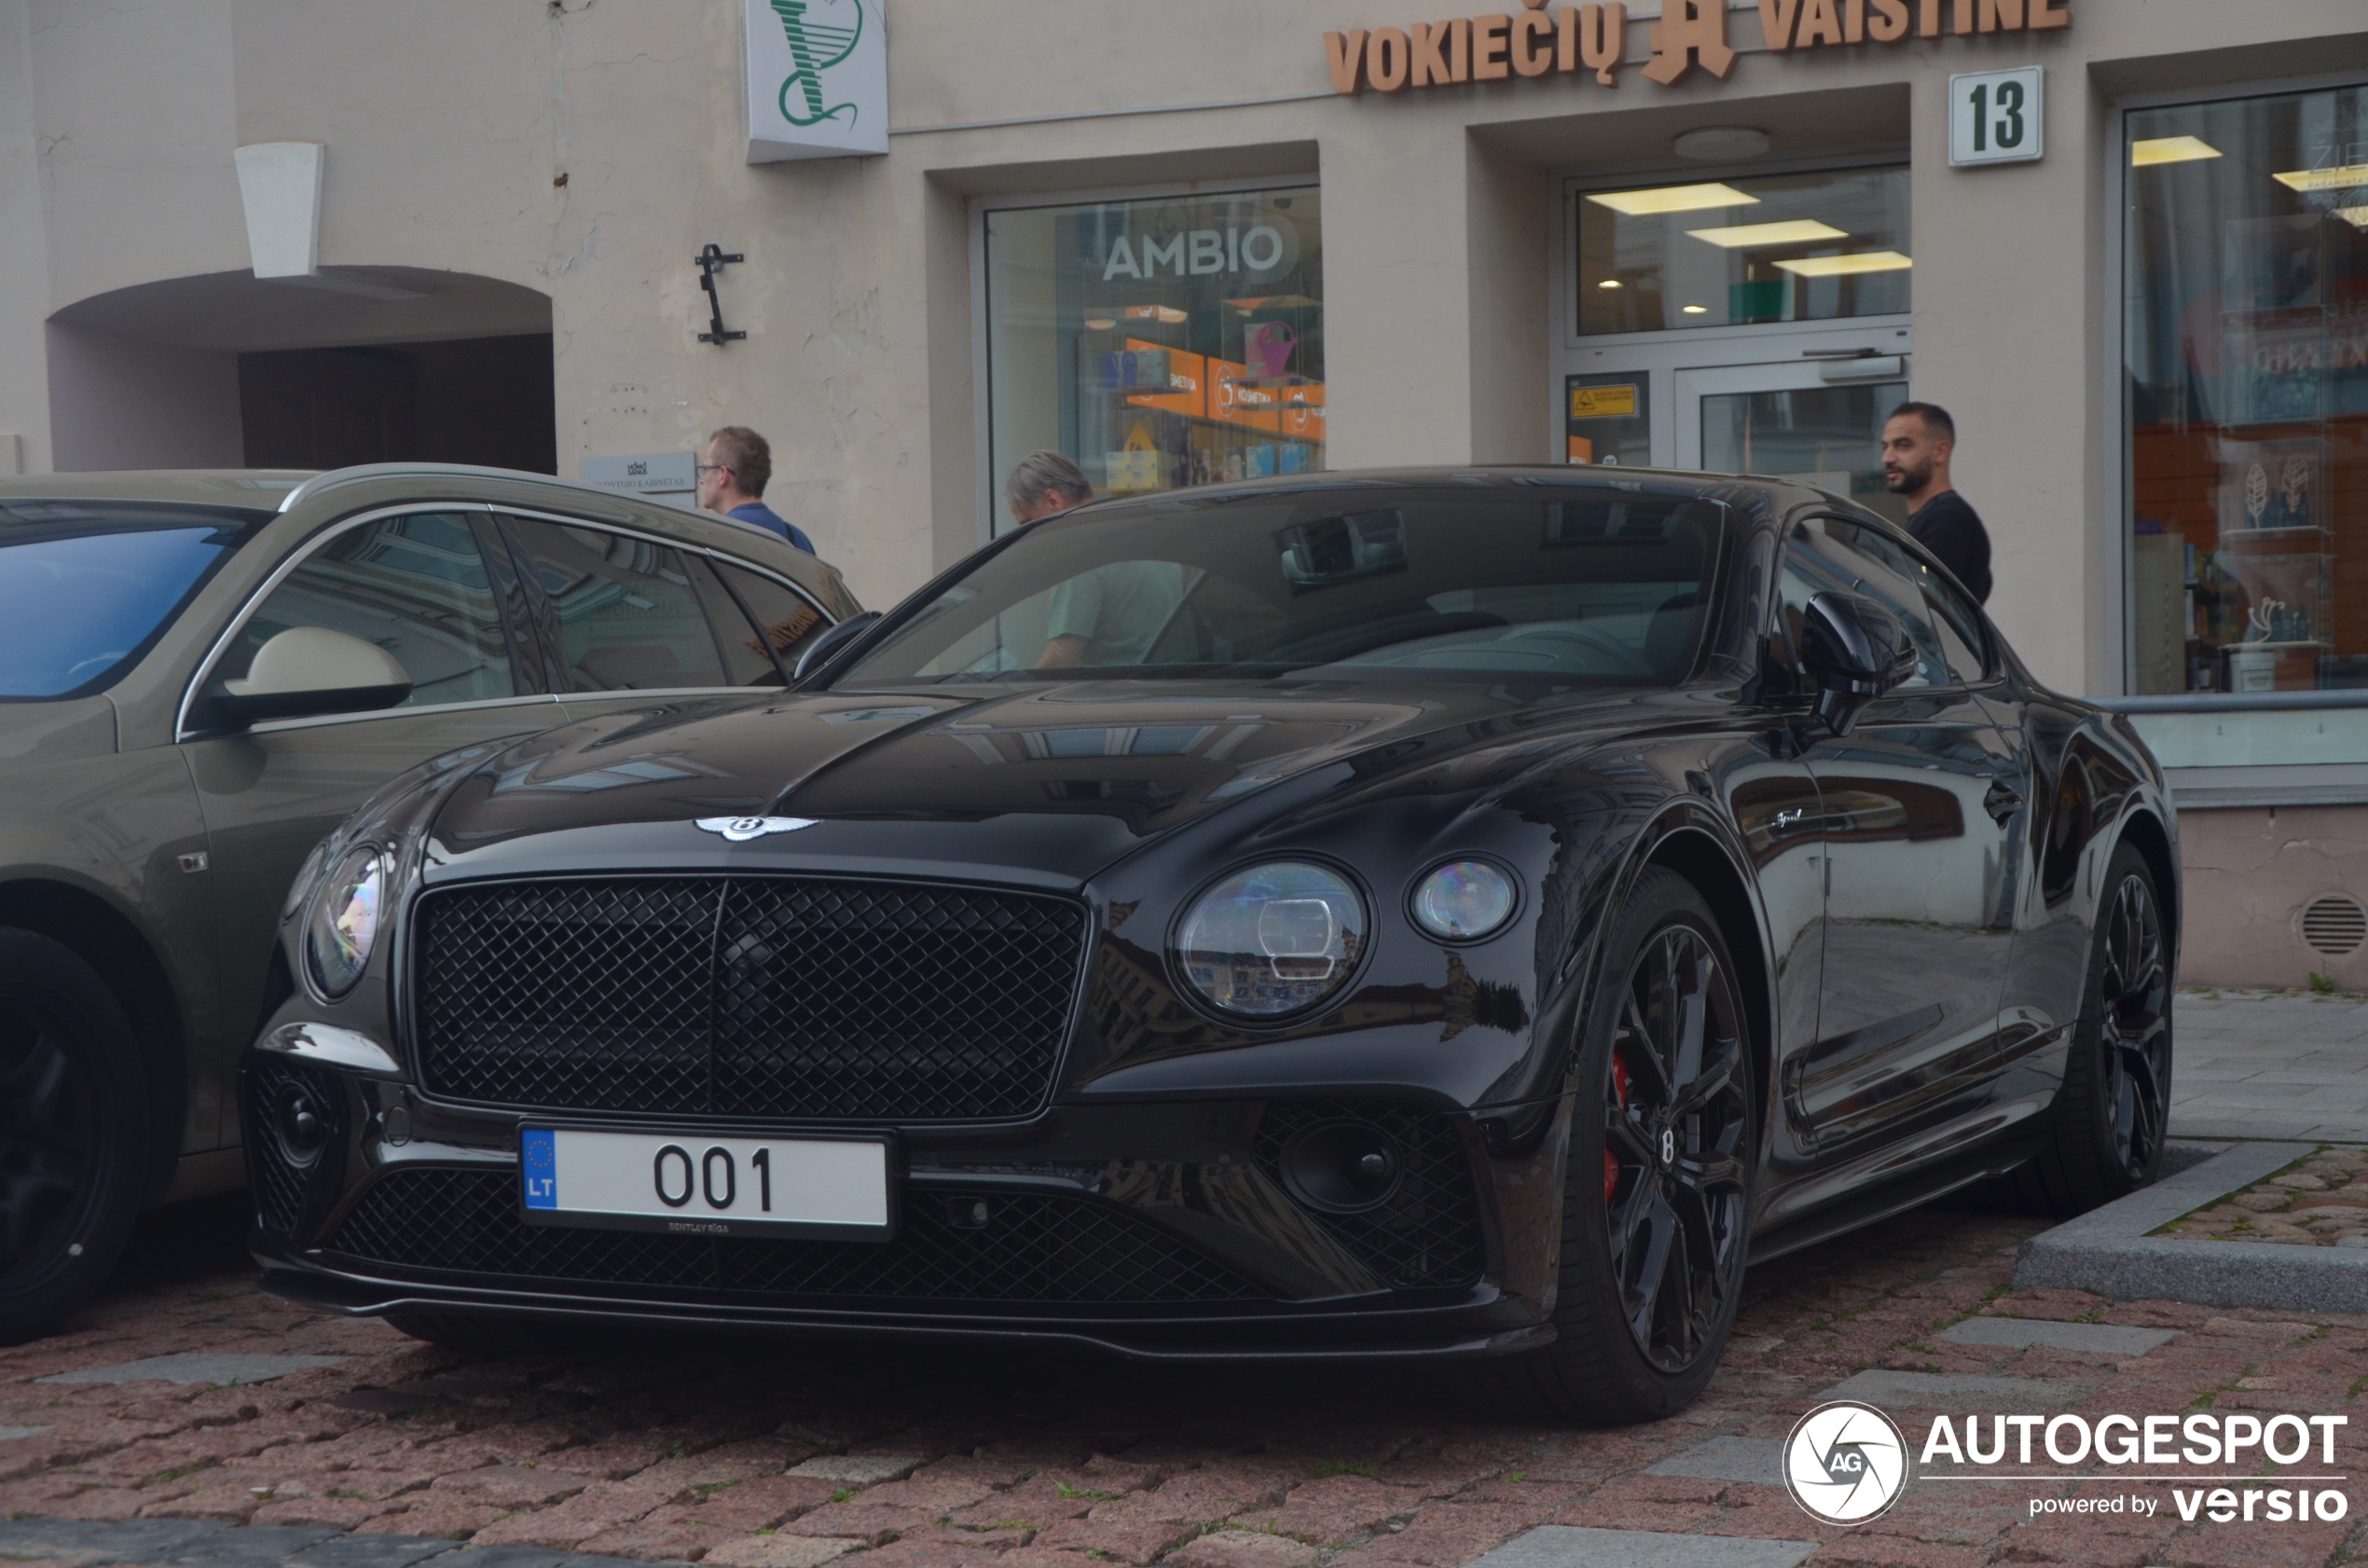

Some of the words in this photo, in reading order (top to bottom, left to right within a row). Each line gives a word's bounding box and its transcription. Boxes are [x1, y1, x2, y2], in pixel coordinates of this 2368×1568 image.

[1322, 0, 1626, 94] VOKIEČIŲ
[1969, 81, 2025, 152] 13
[1103, 226, 1283, 280] AMBIO
[638, 477, 684, 488] KABINETAS
[529, 1178, 554, 1197] LT
[668, 1222, 707, 1232] BENTLEY
